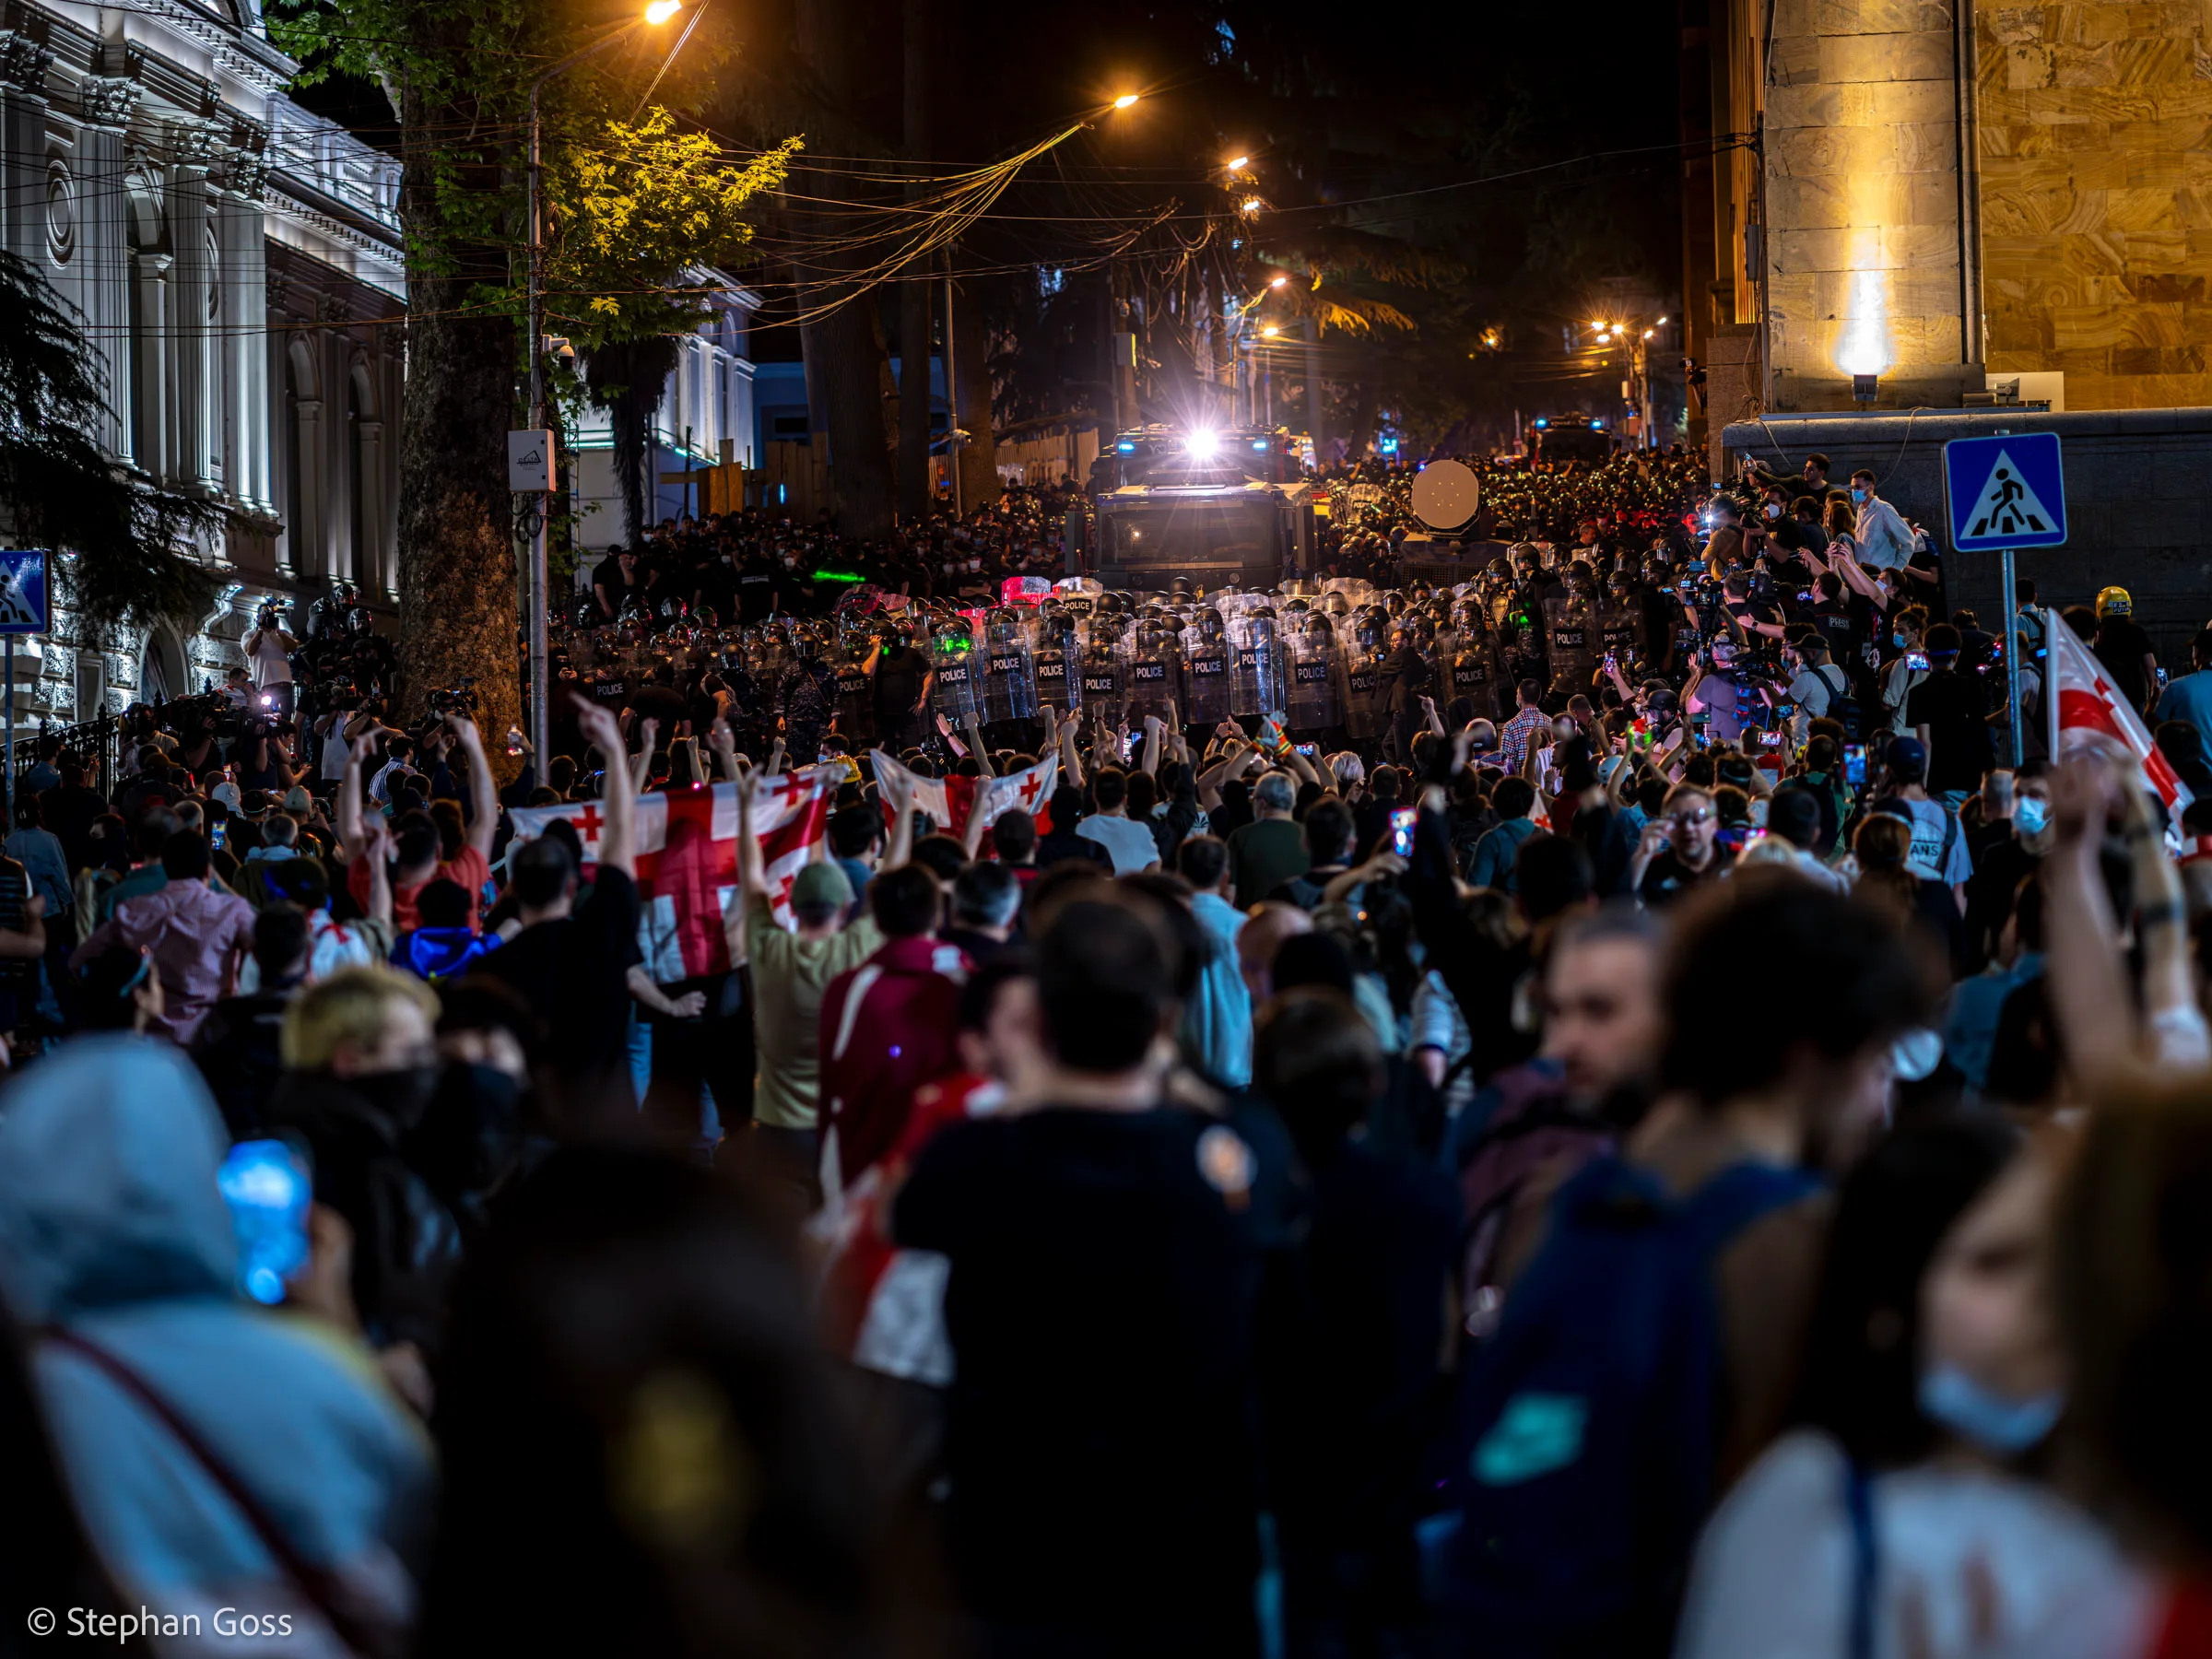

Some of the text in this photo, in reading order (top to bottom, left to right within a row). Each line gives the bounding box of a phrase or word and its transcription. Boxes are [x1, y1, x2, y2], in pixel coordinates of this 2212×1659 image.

[1065, 601, 1090, 611] POLICE
[1830, 617, 1849, 629] PRESS
[1556, 633, 1583, 644] POLICE
[993, 657, 1019, 671] POLICE
[1241, 653, 1269, 665] POLICE
[1039, 665, 1064, 677] POLICE
[1136, 665, 1163, 678] POLICE
[1194, 660, 1221, 674] POLICE
[1298, 666, 1326, 679] POLICE
[939, 668, 967, 683] POLICE
[1456, 669, 1483, 683] POLICE
[597, 682, 623, 695] POLICE
[839, 678, 865, 692] POLICE
[1086, 678, 1112, 690] POLICE
[1351, 676, 1377, 689] POLIC
[1911, 843, 1939, 856] ANS
